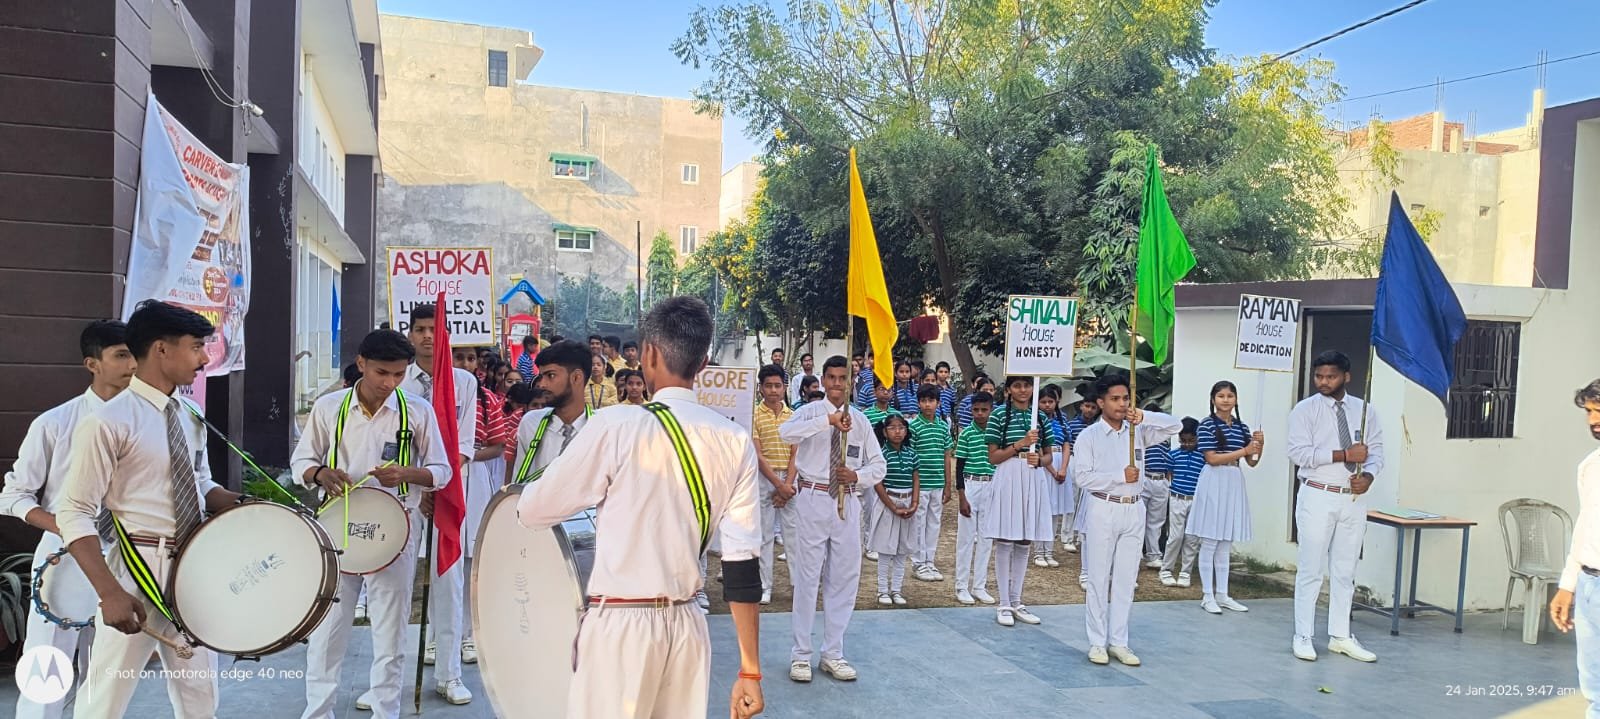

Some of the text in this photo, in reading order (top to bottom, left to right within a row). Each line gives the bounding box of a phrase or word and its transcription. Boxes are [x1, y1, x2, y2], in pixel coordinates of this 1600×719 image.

[392, 250, 490, 276] ASHOKA
[417, 277, 462, 296] HOUSE
[1009, 298, 1078, 326] SHIVAJI
[1240, 295, 1300, 323] RAMAN
[1023, 324, 1055, 342] HOUSE
[1256, 321, 1284, 337] HOUSE
[1016, 346, 1063, 358] HONESTY
[1240, 342, 1292, 357] DEDICATION
[696, 390, 737, 408] HOUSE
